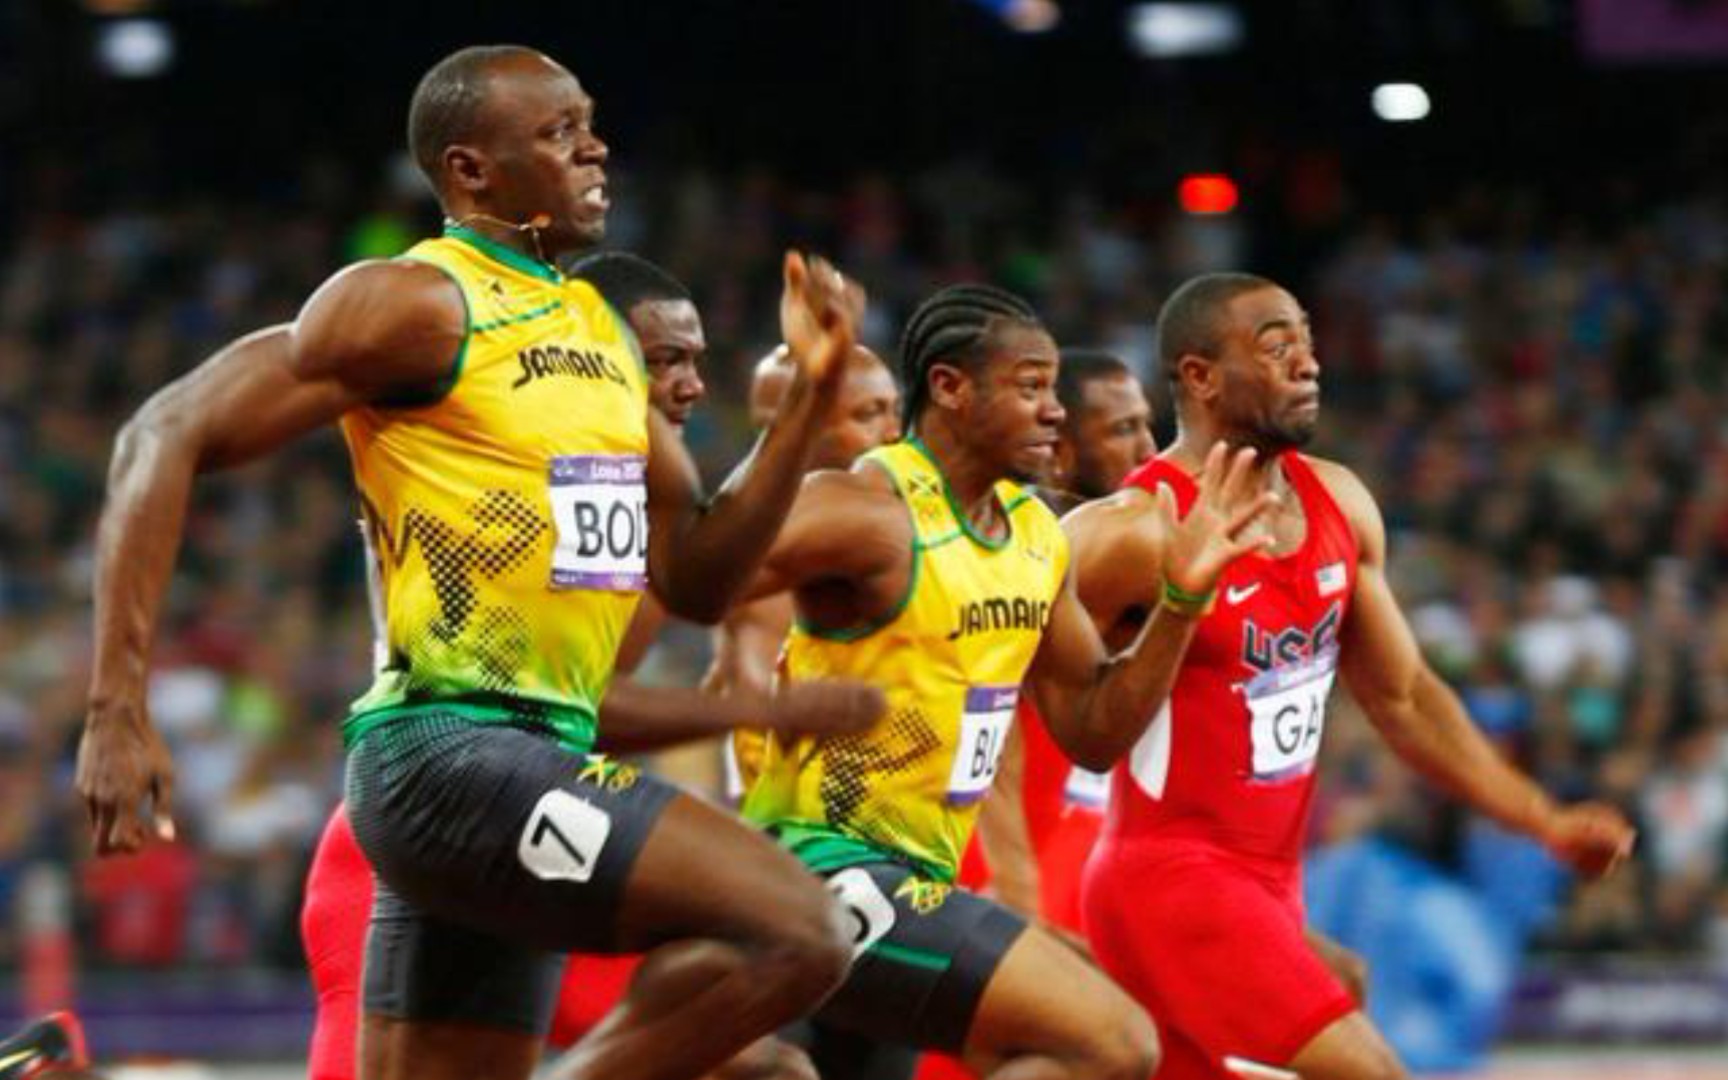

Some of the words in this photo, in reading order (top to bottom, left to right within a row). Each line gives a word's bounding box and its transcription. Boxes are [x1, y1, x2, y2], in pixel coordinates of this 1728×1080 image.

[512, 345, 632, 391] JAMAIC
[574, 500, 649, 559] BOL
[1243, 600, 1340, 672] USA
[530, 814, 586, 868] 7
